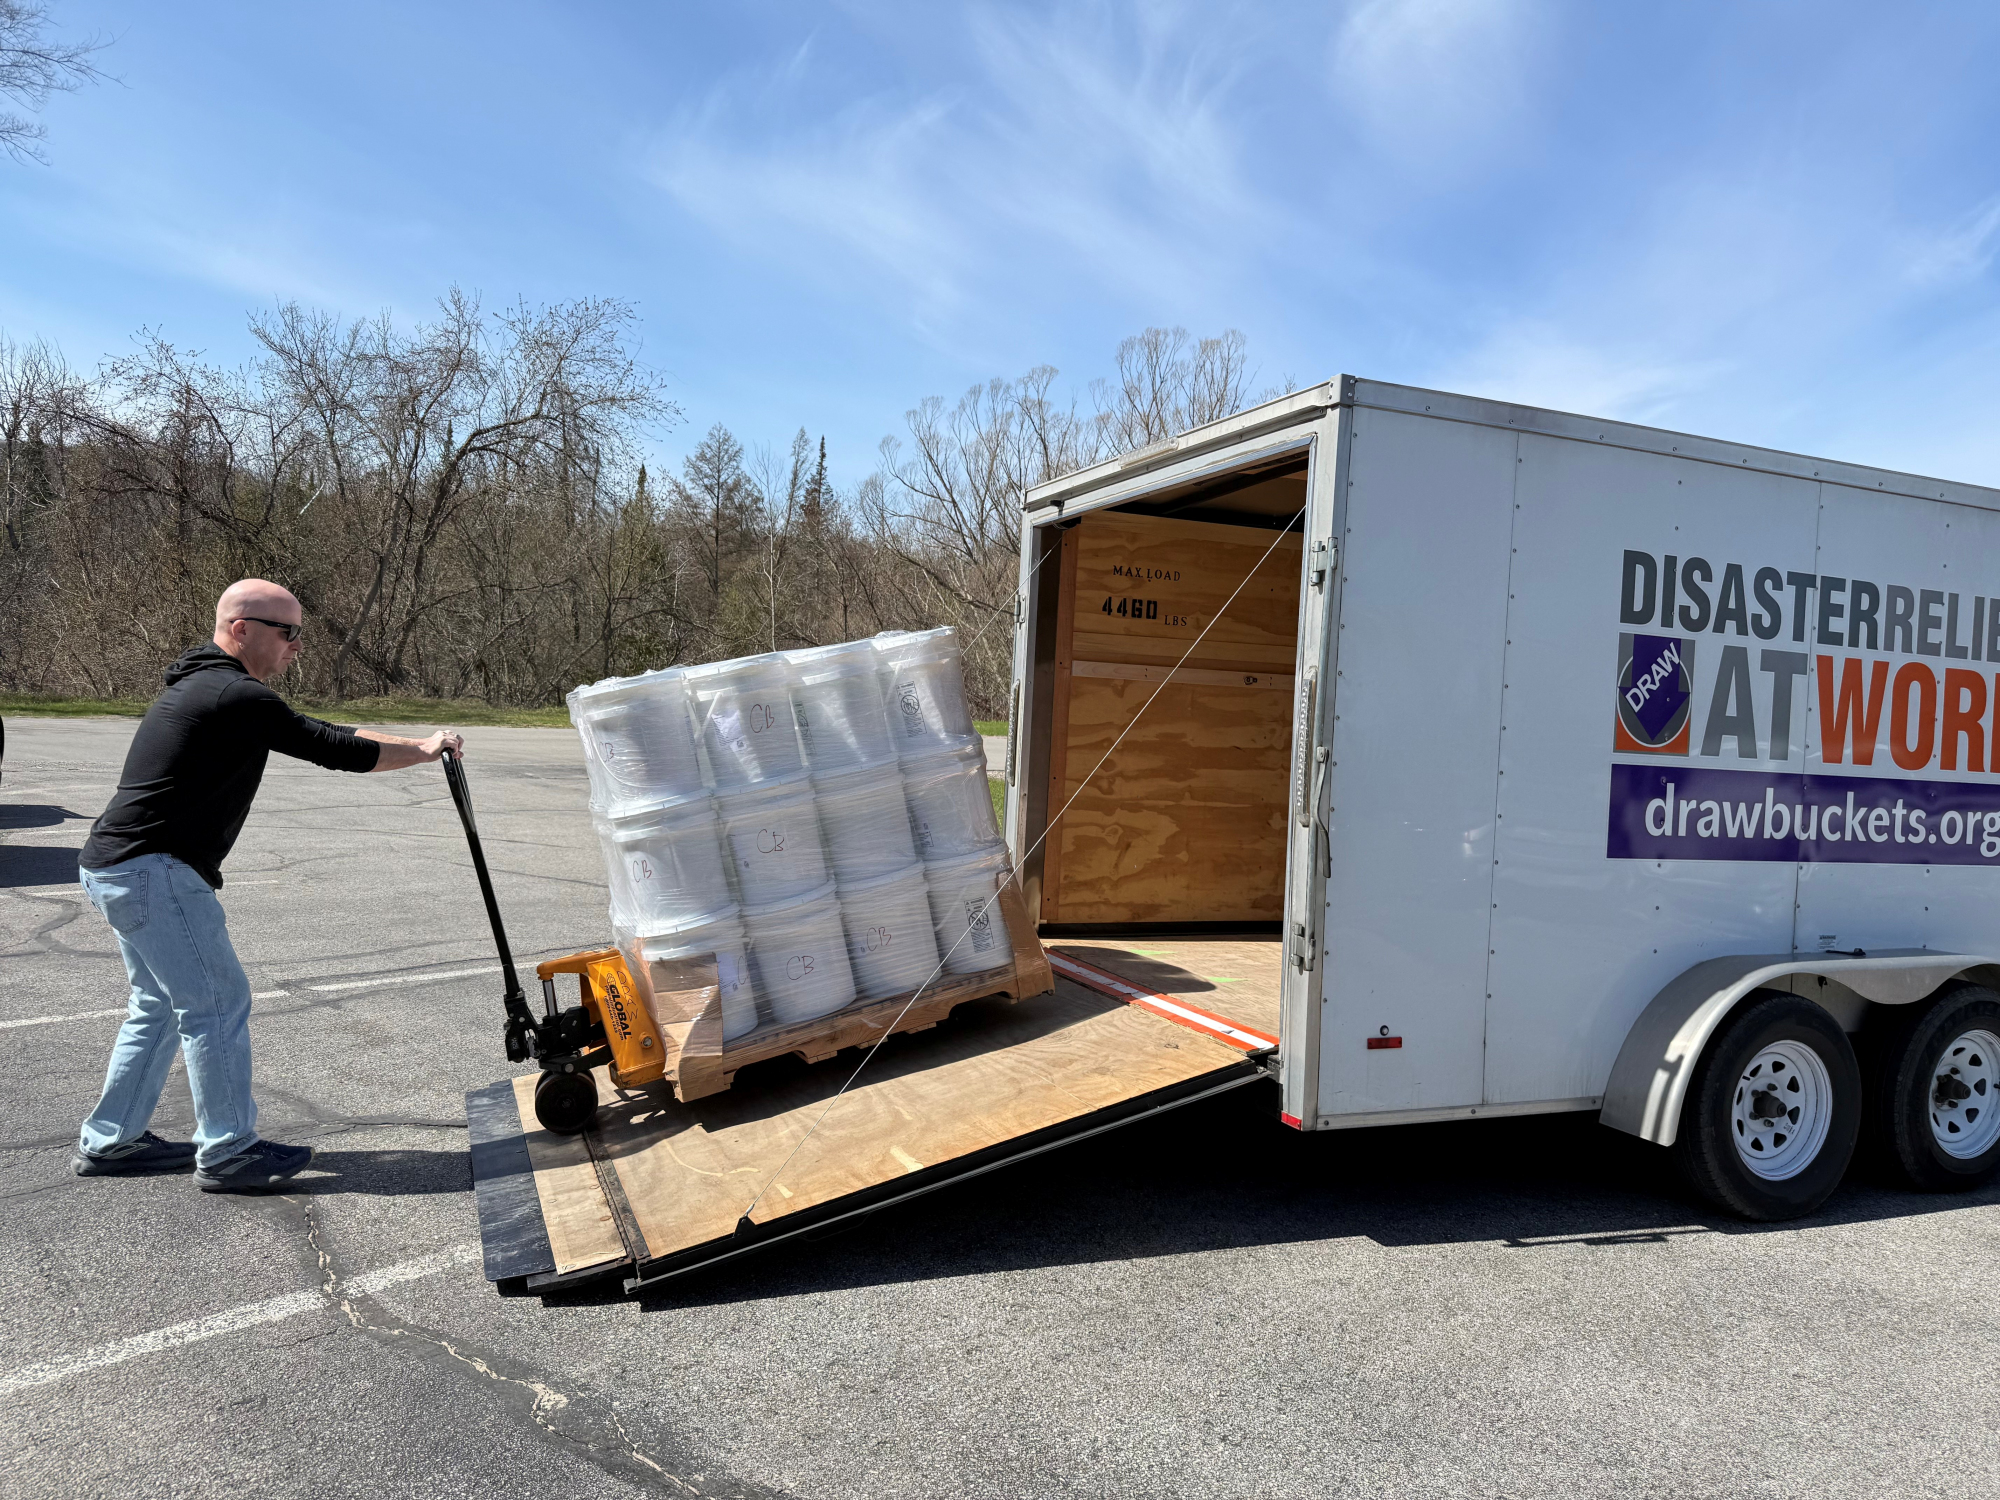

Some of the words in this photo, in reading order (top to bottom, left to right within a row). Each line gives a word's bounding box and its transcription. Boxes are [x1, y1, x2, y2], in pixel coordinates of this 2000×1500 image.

[1113, 565, 1143, 578] MAX
[1147, 569, 1181, 582] LOAD
[1101, 596, 1158, 620] 4460
[1164, 615, 1188, 627] LBS
[1625, 642, 1682, 713] DRAW
[1700, 644, 1809, 761] AT
[1644, 782, 2000, 858] drawbuckets.org
[756, 828, 785, 854] CB
[632, 859, 653, 884] CB
[866, 926, 892, 952] CB
[786, 955, 815, 981] CB
[609, 984, 632, 1040] GLOBAL
